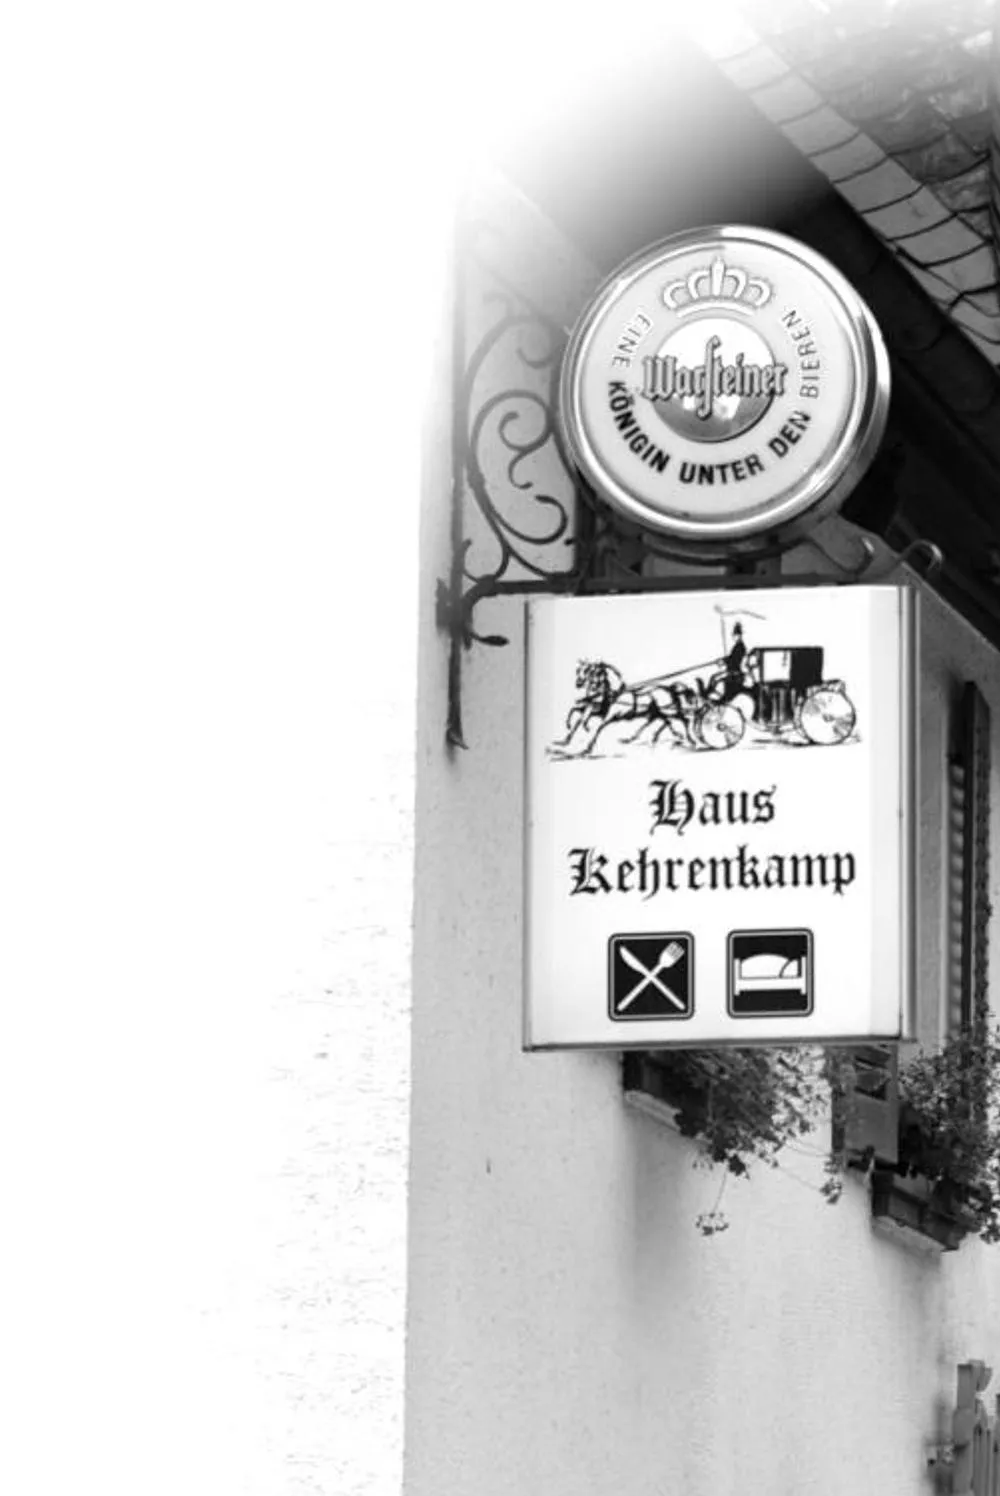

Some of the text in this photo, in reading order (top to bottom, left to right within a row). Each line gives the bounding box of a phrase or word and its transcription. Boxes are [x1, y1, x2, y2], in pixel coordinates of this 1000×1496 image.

[607, 307, 821, 486] EINE KÖNIGIN UNTER DEN BIEREN
[641, 334, 789, 422] Warsteiner
[648, 779, 778, 836] Haus
[567, 844, 857, 901] Kehrenkamp
